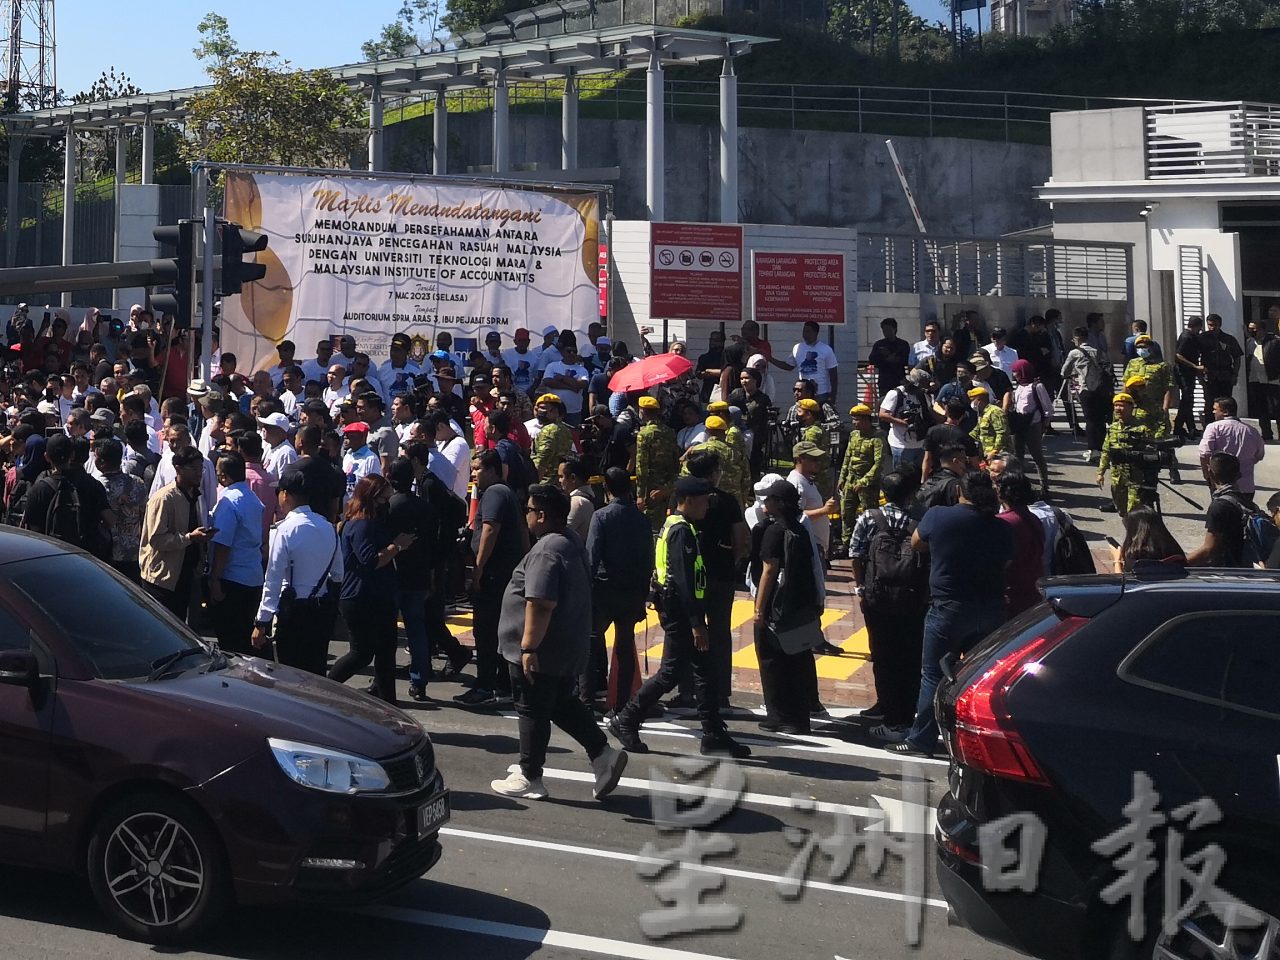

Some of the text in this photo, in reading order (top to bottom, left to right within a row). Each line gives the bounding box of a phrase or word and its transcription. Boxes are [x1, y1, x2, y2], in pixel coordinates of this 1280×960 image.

[312, 189, 542, 228] Majlis Menandatangani
[314, 219, 538, 241] MEMORANDUM PERSEFAHAMAN ANTARA
[294, 233, 562, 257] SURUHANJAYA PENCEGAHAN RASUAH MALAYSIA
[308, 248, 542, 270] DENGAN UNIVERSITI TEKNOLOGI MARA &
[314, 263, 535, 283] MALAYSIAN INSTITUTE OF ACCOUNTANTS
[388, 292, 468, 302] 7 MAC 2023 (SELASA)
[343, 312, 390, 322] AUDITORIUM
[412, 315, 432, 323] ARAS
[433, 315, 440, 324] 3,
[442, 316, 454, 324] IBU
[456, 316, 485, 325] PEJABAT
[486, 317, 509, 326] SPRM
